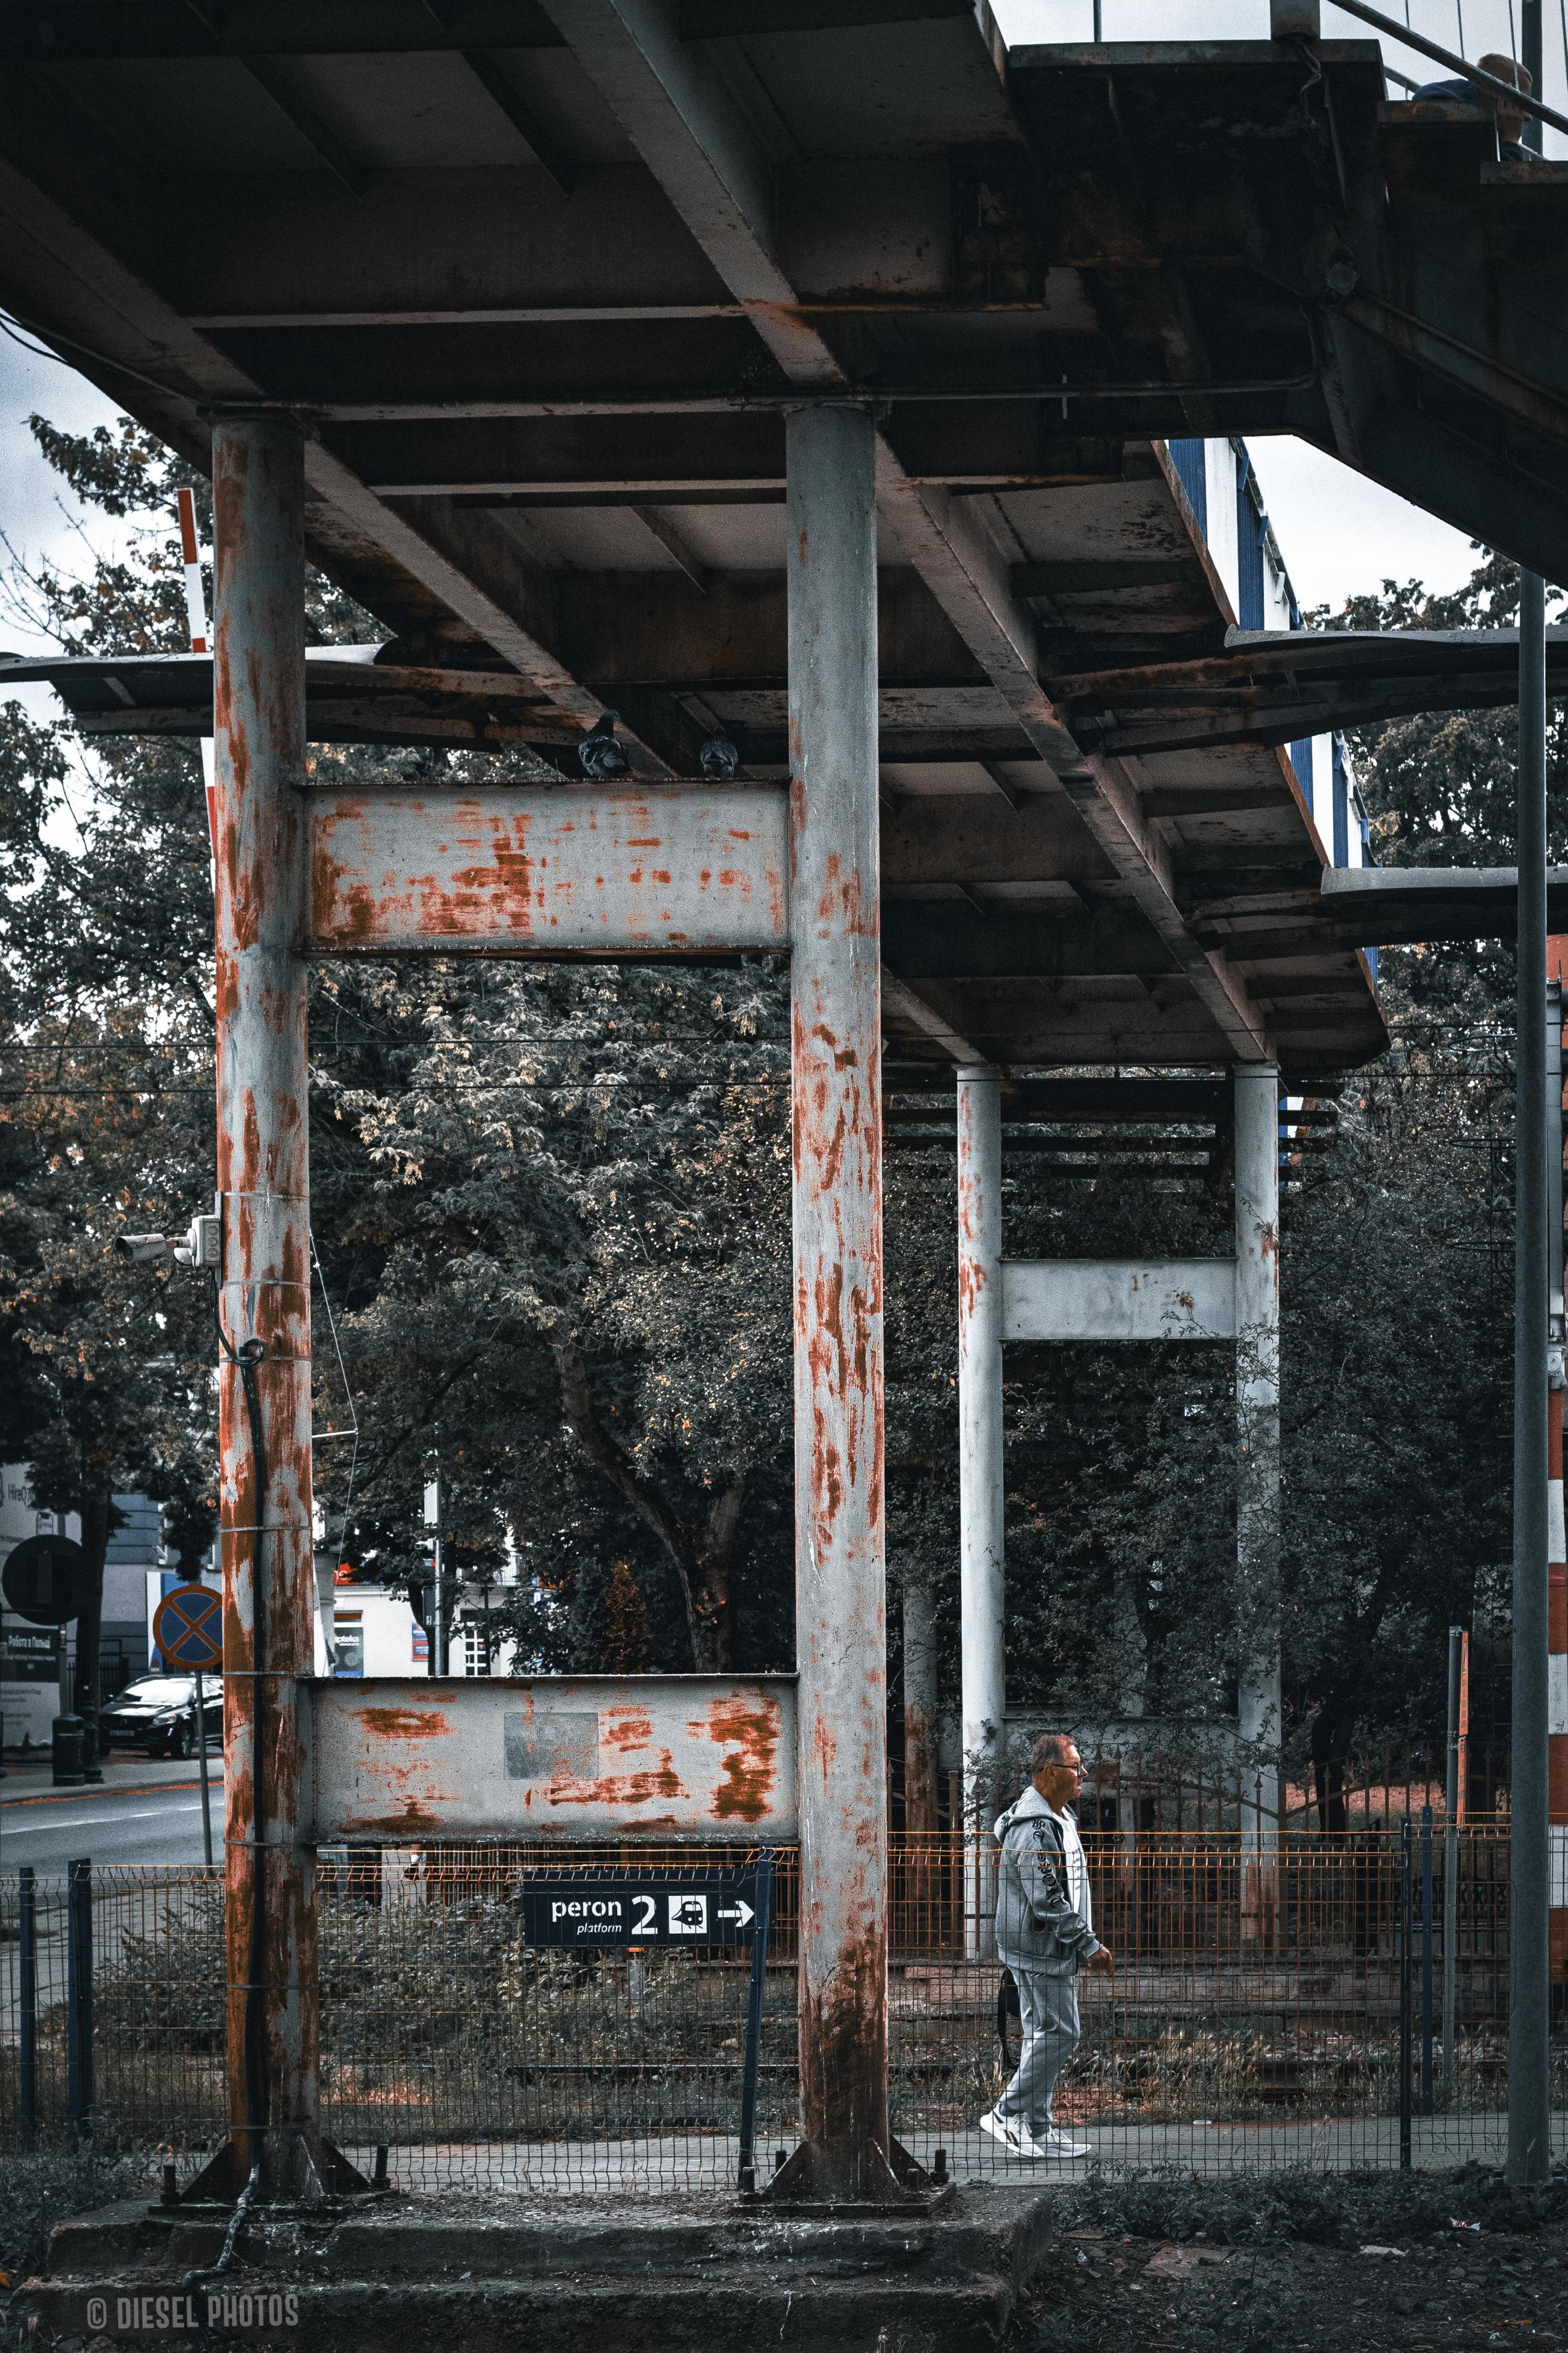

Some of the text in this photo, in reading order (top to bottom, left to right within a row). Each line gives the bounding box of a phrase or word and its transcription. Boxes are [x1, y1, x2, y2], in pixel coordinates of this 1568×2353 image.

[552, 1895, 658, 1935] peron 2
[578, 1923, 622, 1935] platform
